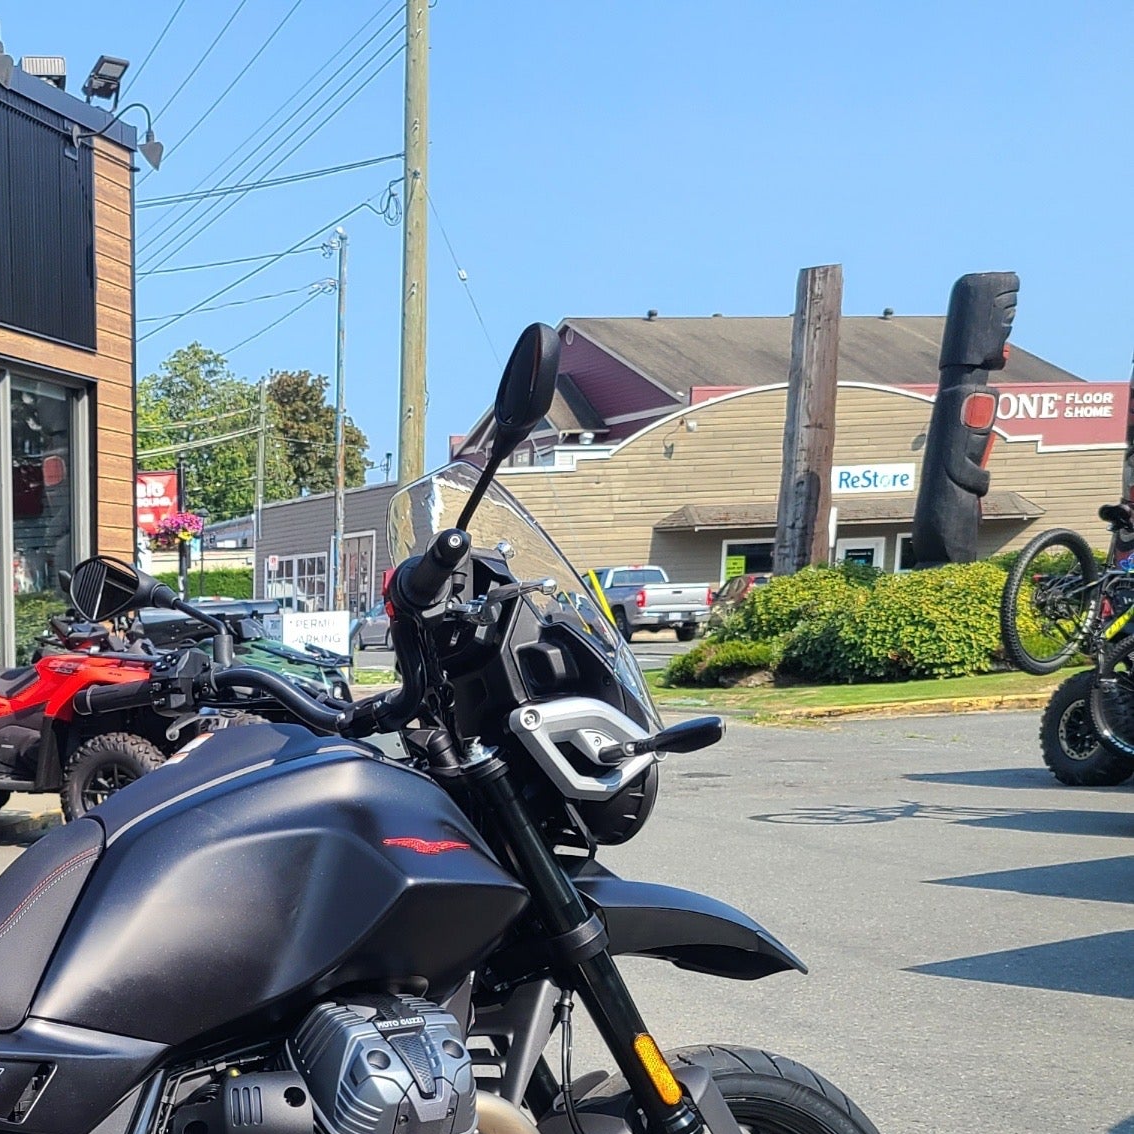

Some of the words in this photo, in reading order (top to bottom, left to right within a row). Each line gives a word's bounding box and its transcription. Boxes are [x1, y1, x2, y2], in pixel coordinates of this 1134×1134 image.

[996, 393, 1059, 420] ONE
[1066, 392, 1114, 404] FLOOR
[1063, 406, 1114, 418] &HOME
[838, 469, 910, 489] ReStore
[376, 1020, 400, 1028] MOTO
[400, 1017, 424, 1025] GUZZI
